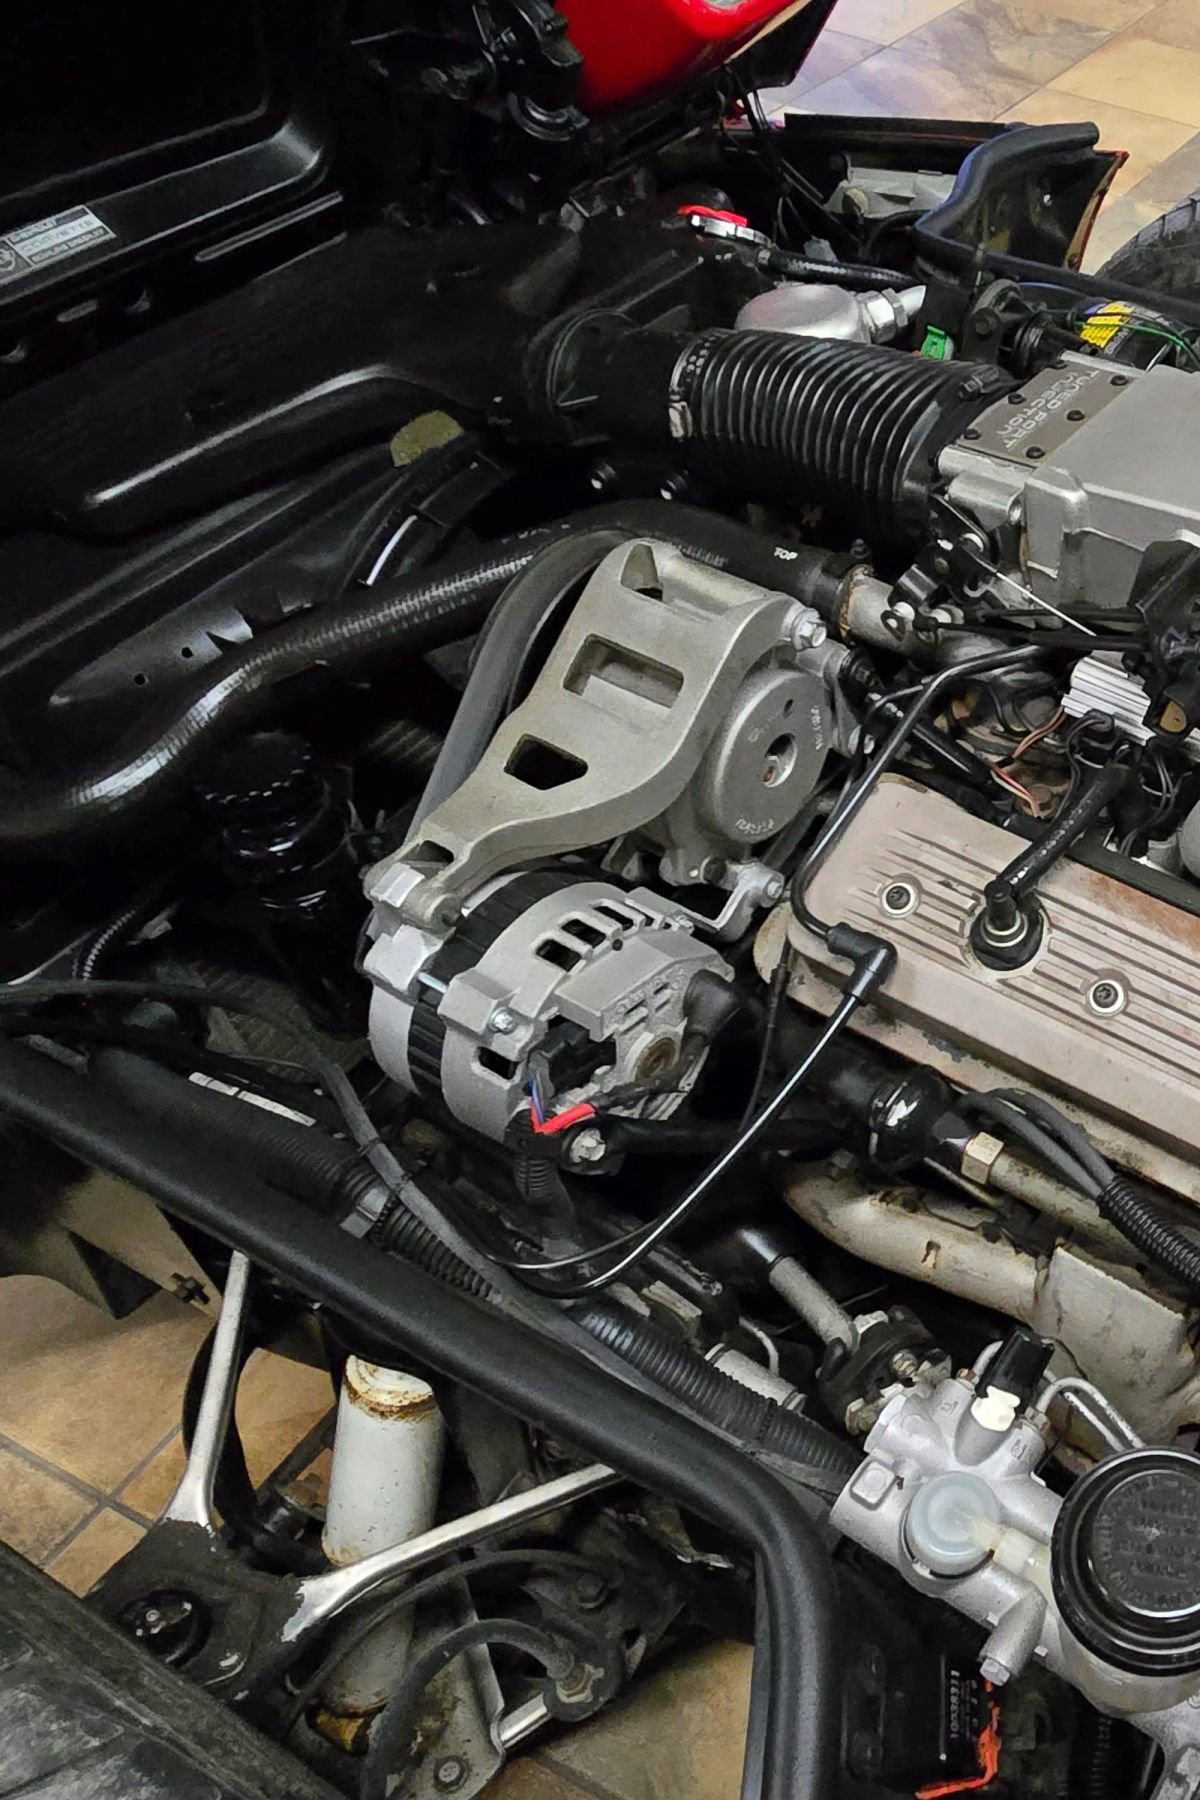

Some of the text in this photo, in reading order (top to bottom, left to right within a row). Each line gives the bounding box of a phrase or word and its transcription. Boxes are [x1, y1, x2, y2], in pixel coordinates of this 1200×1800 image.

[996, 372, 1079, 436] INJECTION
[1002, 369, 1100, 449] TUNED PORT
[773, 546, 799, 561] TOP
